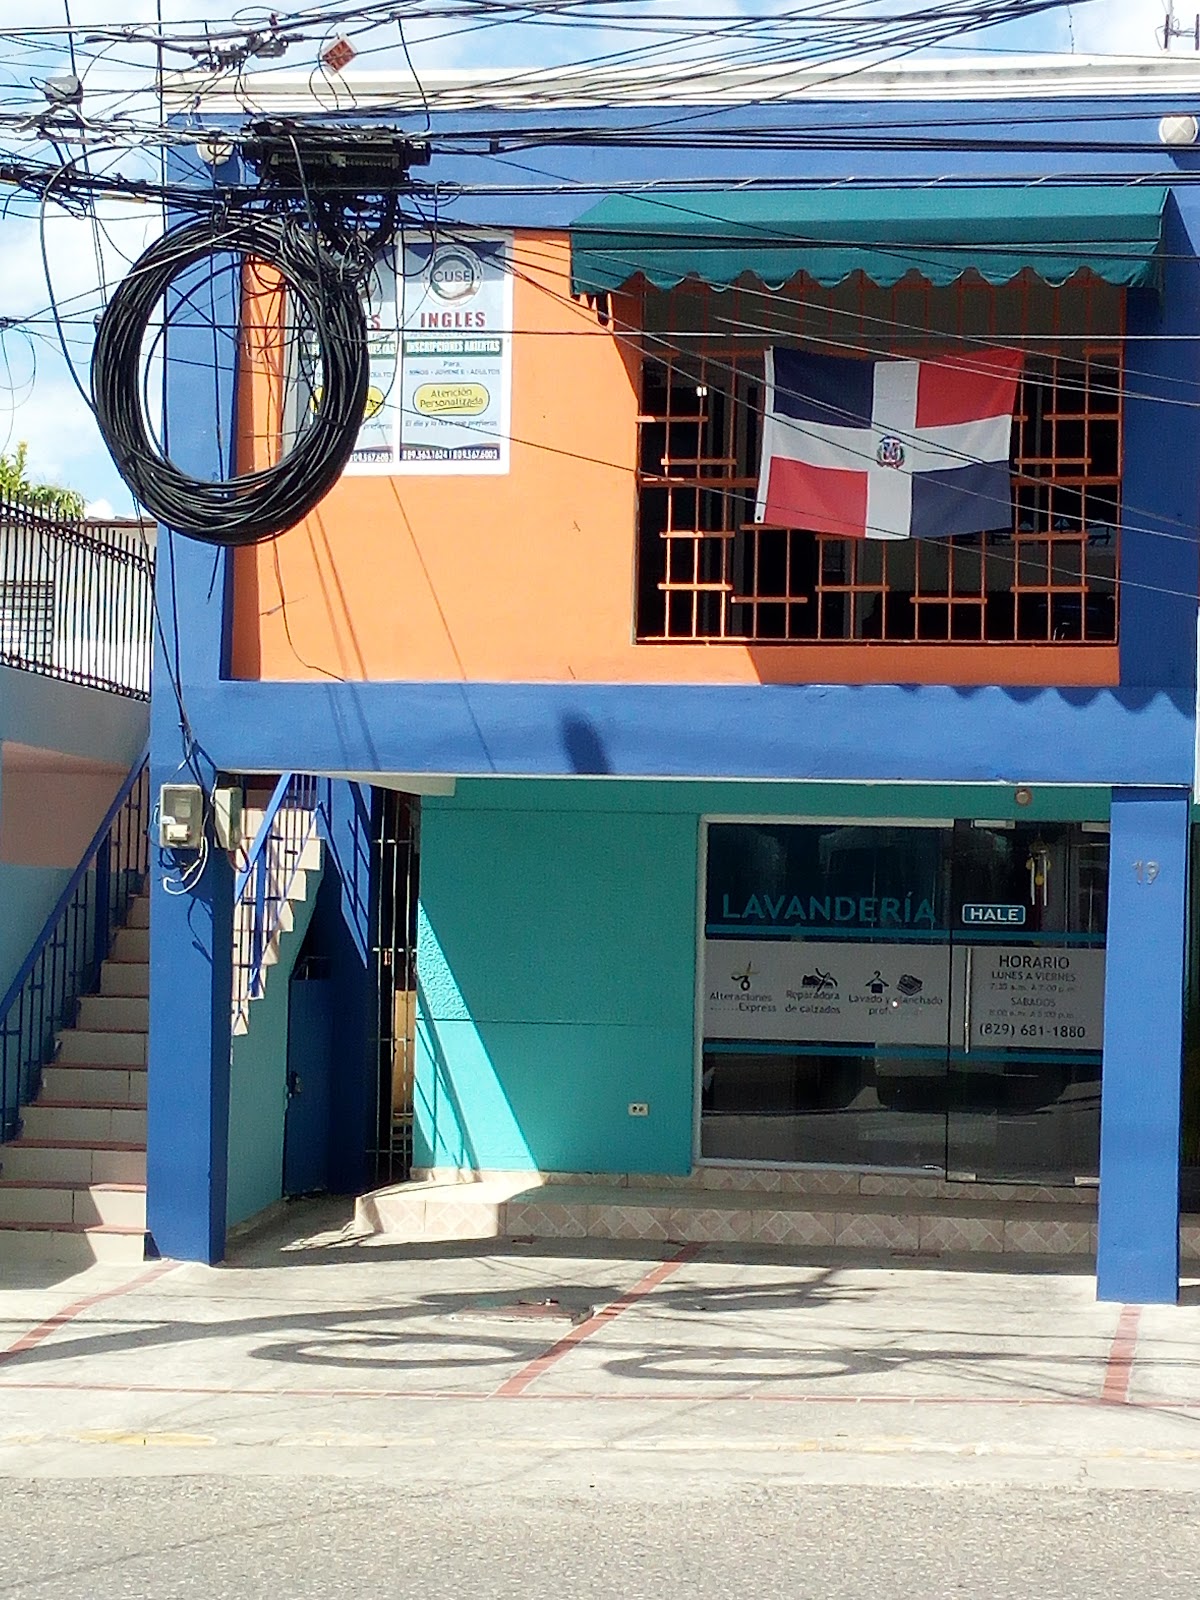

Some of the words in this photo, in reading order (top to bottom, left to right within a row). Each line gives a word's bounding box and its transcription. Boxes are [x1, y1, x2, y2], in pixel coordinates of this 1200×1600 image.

[433, 270, 471, 283] CUSE
[420, 311, 486, 328] INGLES
[430, 388, 472, 398] Atención
[420, 397, 484, 408] Personalizada
[1131, 860, 1161, 885] 19
[722, 891, 937, 924] LAVANDERÍA
[970, 907, 1019, 921] HALE
[998, 954, 1070, 970] HORARIO
[991, 970, 1024, 980] LUNES
[1025, 972, 1033, 981] A
[1035, 971, 1077, 983] VIERNES
[709, 990, 773, 1002] Alteraciones
[786, 989, 840, 1002] Reparadora
[849, 993, 883, 1005] Lavado
[785, 1004, 797, 1013] de
[799, 1004, 841, 1015] calzados
[979, 1023, 1015, 1038] (829)
[1020, 1024, 1086, 1038] 681-1880
